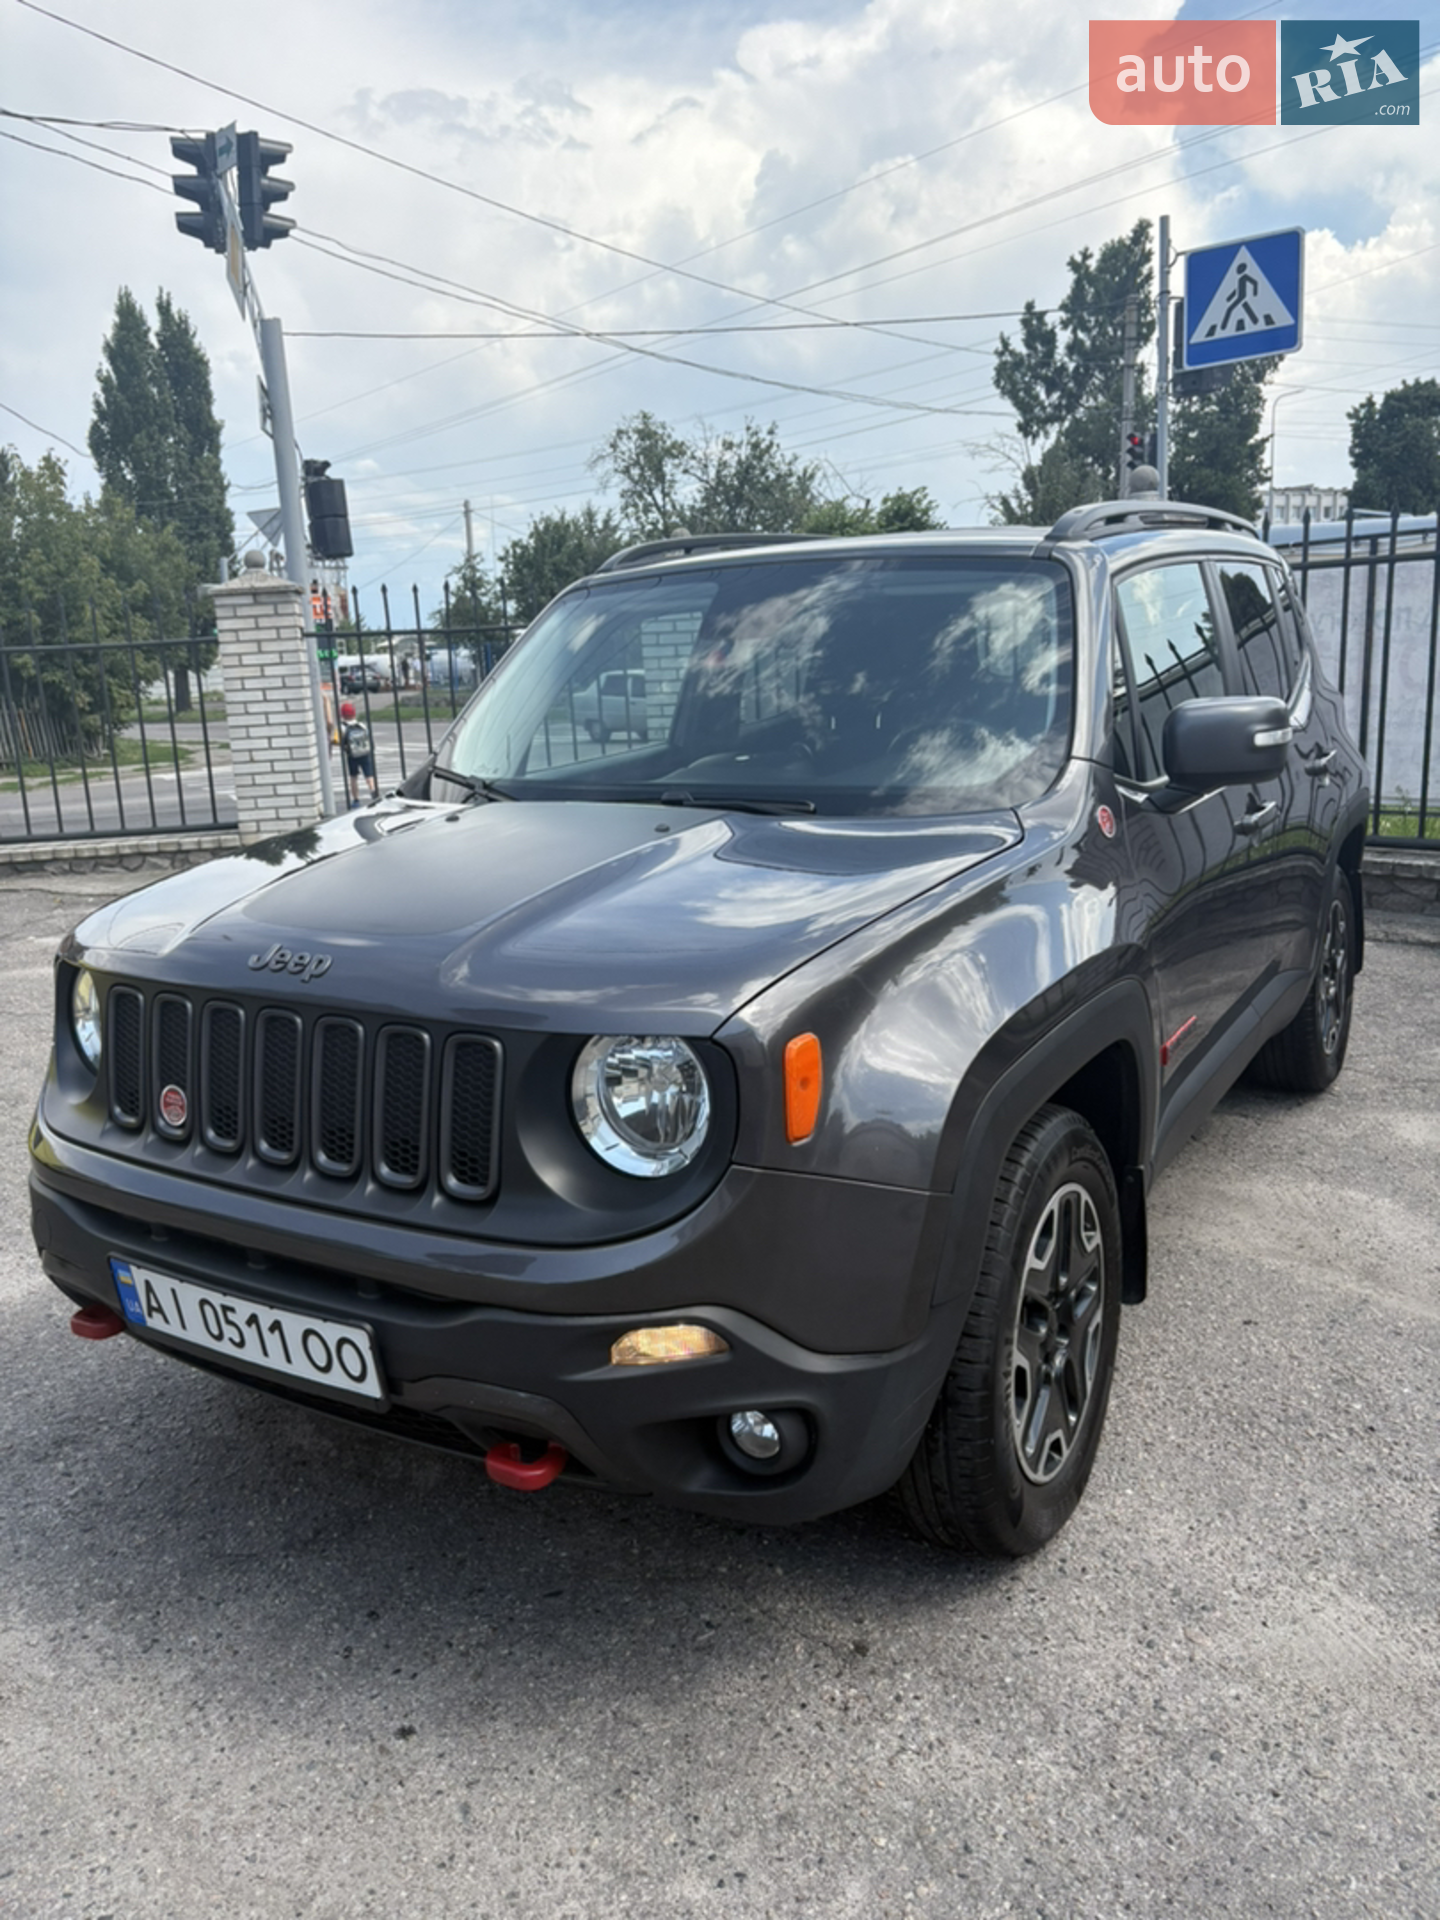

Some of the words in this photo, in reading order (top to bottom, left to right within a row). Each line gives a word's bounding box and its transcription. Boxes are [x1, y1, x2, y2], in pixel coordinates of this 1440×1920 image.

[247, 943, 333, 983] Jeep
[125, 1298, 143, 1314] UA
[144, 1278, 188, 1331] AI
[198, 1297, 293, 1365] 0511
[301, 1327, 368, 1384] OO
